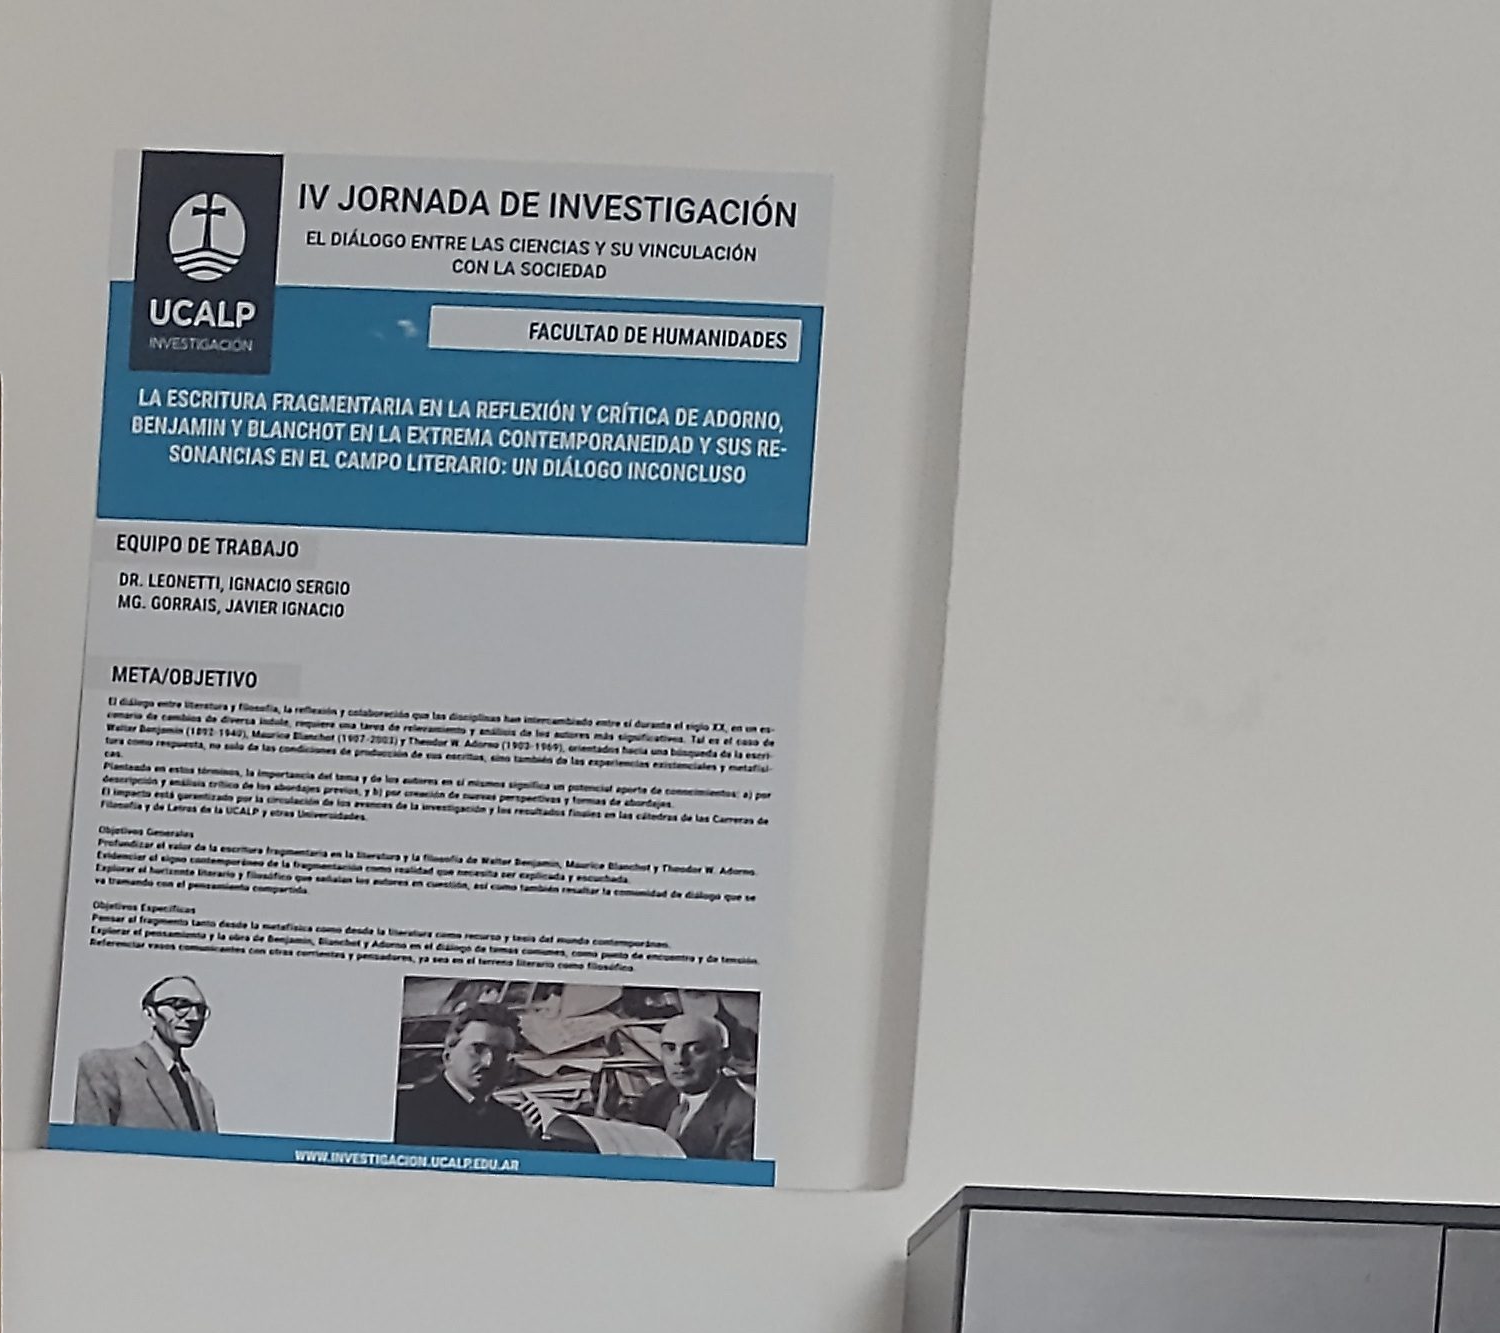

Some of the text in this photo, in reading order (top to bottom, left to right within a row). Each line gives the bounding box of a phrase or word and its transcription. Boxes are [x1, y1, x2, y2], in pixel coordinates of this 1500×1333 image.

[299, 183, 796, 228] IV JORNADA DE INVESTIGACIÓN
[307, 229, 756, 262] EL DIÁLOGO ENTRE LAS CIENCIAS Y SU VINCULACIÓN
[452, 259, 606, 279] CON LA SOCIEDAD
[150, 299, 255, 328] UCALP
[149, 337, 253, 352] INVESTIGACIÓN
[529, 322, 787, 349] FACULTAD DE HUMANIDADES
[139, 388, 783, 433] LA ESCRITURA FRAGMENTARIA EN LA REFLEXIÓN Y CRÍTICA DE ADORNO,
[132, 416, 787, 457] BENJAMIN Y BLANCHOT EN LA EXTREMA CONTEMPORANEIDAD Y SUS RE-
[169, 445, 746, 484] SONANCIAS EN EL CAMPO LITERARIO: UN DIÁLOGO INCONCLUSO
[117, 534, 298, 557] EQUIPO DE TRABAJO
[119, 572, 350, 595] DR. LEONETTI, IGNACIO SERGIO
[118, 594, 344, 618] MG. GORRAIS, JAVIER IGNACIO
[112, 665, 257, 688] META/OBJETIVO
[225, 806, 259, 816] UCALP
